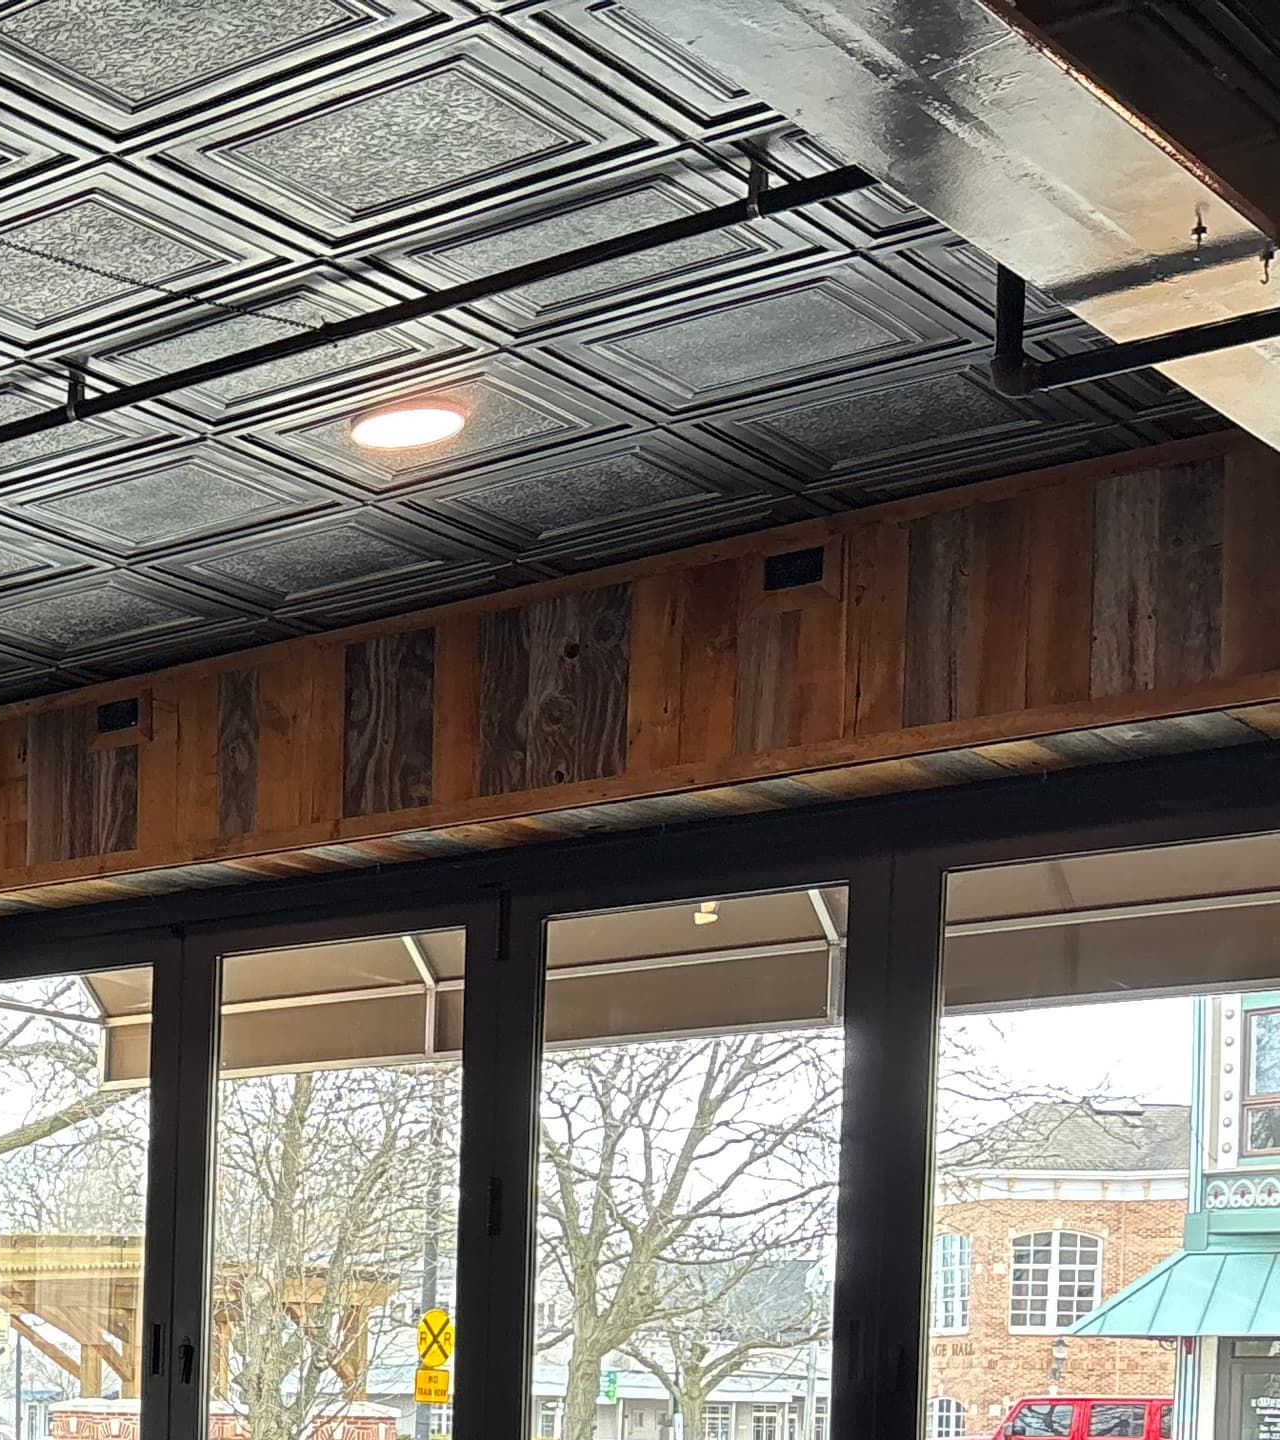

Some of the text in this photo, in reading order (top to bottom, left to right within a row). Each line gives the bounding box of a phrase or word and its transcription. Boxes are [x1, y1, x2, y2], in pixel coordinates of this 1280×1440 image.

[420, 1331, 451, 1346] R R
[951, 1343, 976, 1356] HALL
